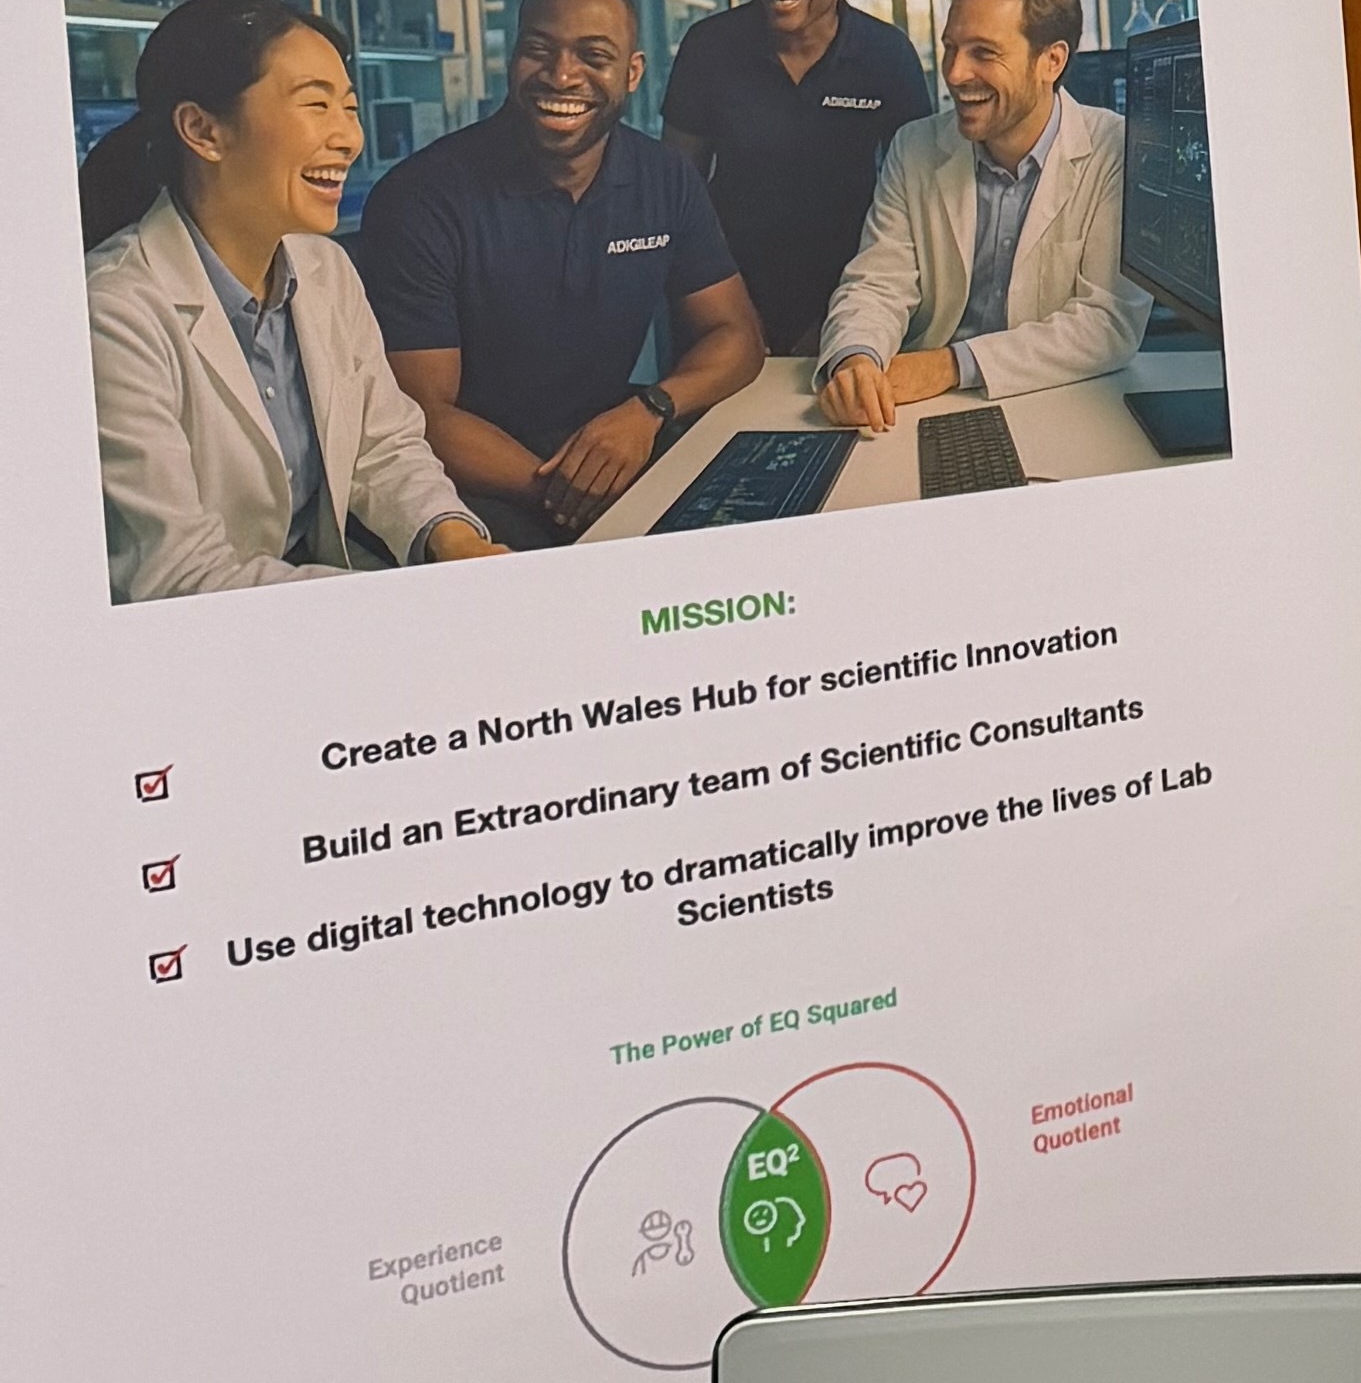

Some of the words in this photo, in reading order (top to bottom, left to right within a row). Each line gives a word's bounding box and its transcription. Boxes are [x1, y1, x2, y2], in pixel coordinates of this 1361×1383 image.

[822, 96, 881, 109] ADIGILEAP
[607, 234, 670, 254] ADIGILEAP
[641, 590, 796, 636] MISSION:
[321, 732, 437, 771] Create
[448, 729, 468, 751] a
[477, 707, 573, 746] North
[581, 695, 682, 729] Wales
[692, 679, 758, 713] Hub
[765, 674, 812, 701] for
[820, 648, 958, 692] scientific
[966, 625, 1118, 668] Innovation
[302, 822, 392, 864] Build
[402, 820, 443, 846] an
[454, 780, 680, 837] Extraordinary
[688, 765, 770, 797] team
[780, 752, 812, 781] of
[820, 729, 962, 774] Scientific
[969, 698, 1144, 747] Consultants
[227, 936, 296, 967] Use
[307, 907, 414, 952] digital
[422, 877, 612, 930] technology
[620, 868, 654, 894] to
[663, 829, 860, 891] dramatically
[868, 808, 989, 849] improve
[996, 796, 1043, 823] the
[1052, 784, 1117, 813] lives
[1125, 770, 1153, 799] of
[1161, 761, 1213, 793] Lab
[677, 878, 834, 927] Scientists
[609, 1041, 656, 1065] The
[661, 1025, 734, 1056] Power
[740, 1014, 763, 1039] of
[769, 1009, 800, 1033] EQ
[807, 986, 898, 1025] Squared
[1031, 1082, 1134, 1126] Emotional
[1032, 1116, 1121, 1155] Quotient
[368, 1232, 503, 1283] Experience
[400, 1263, 506, 1307] Quotient
